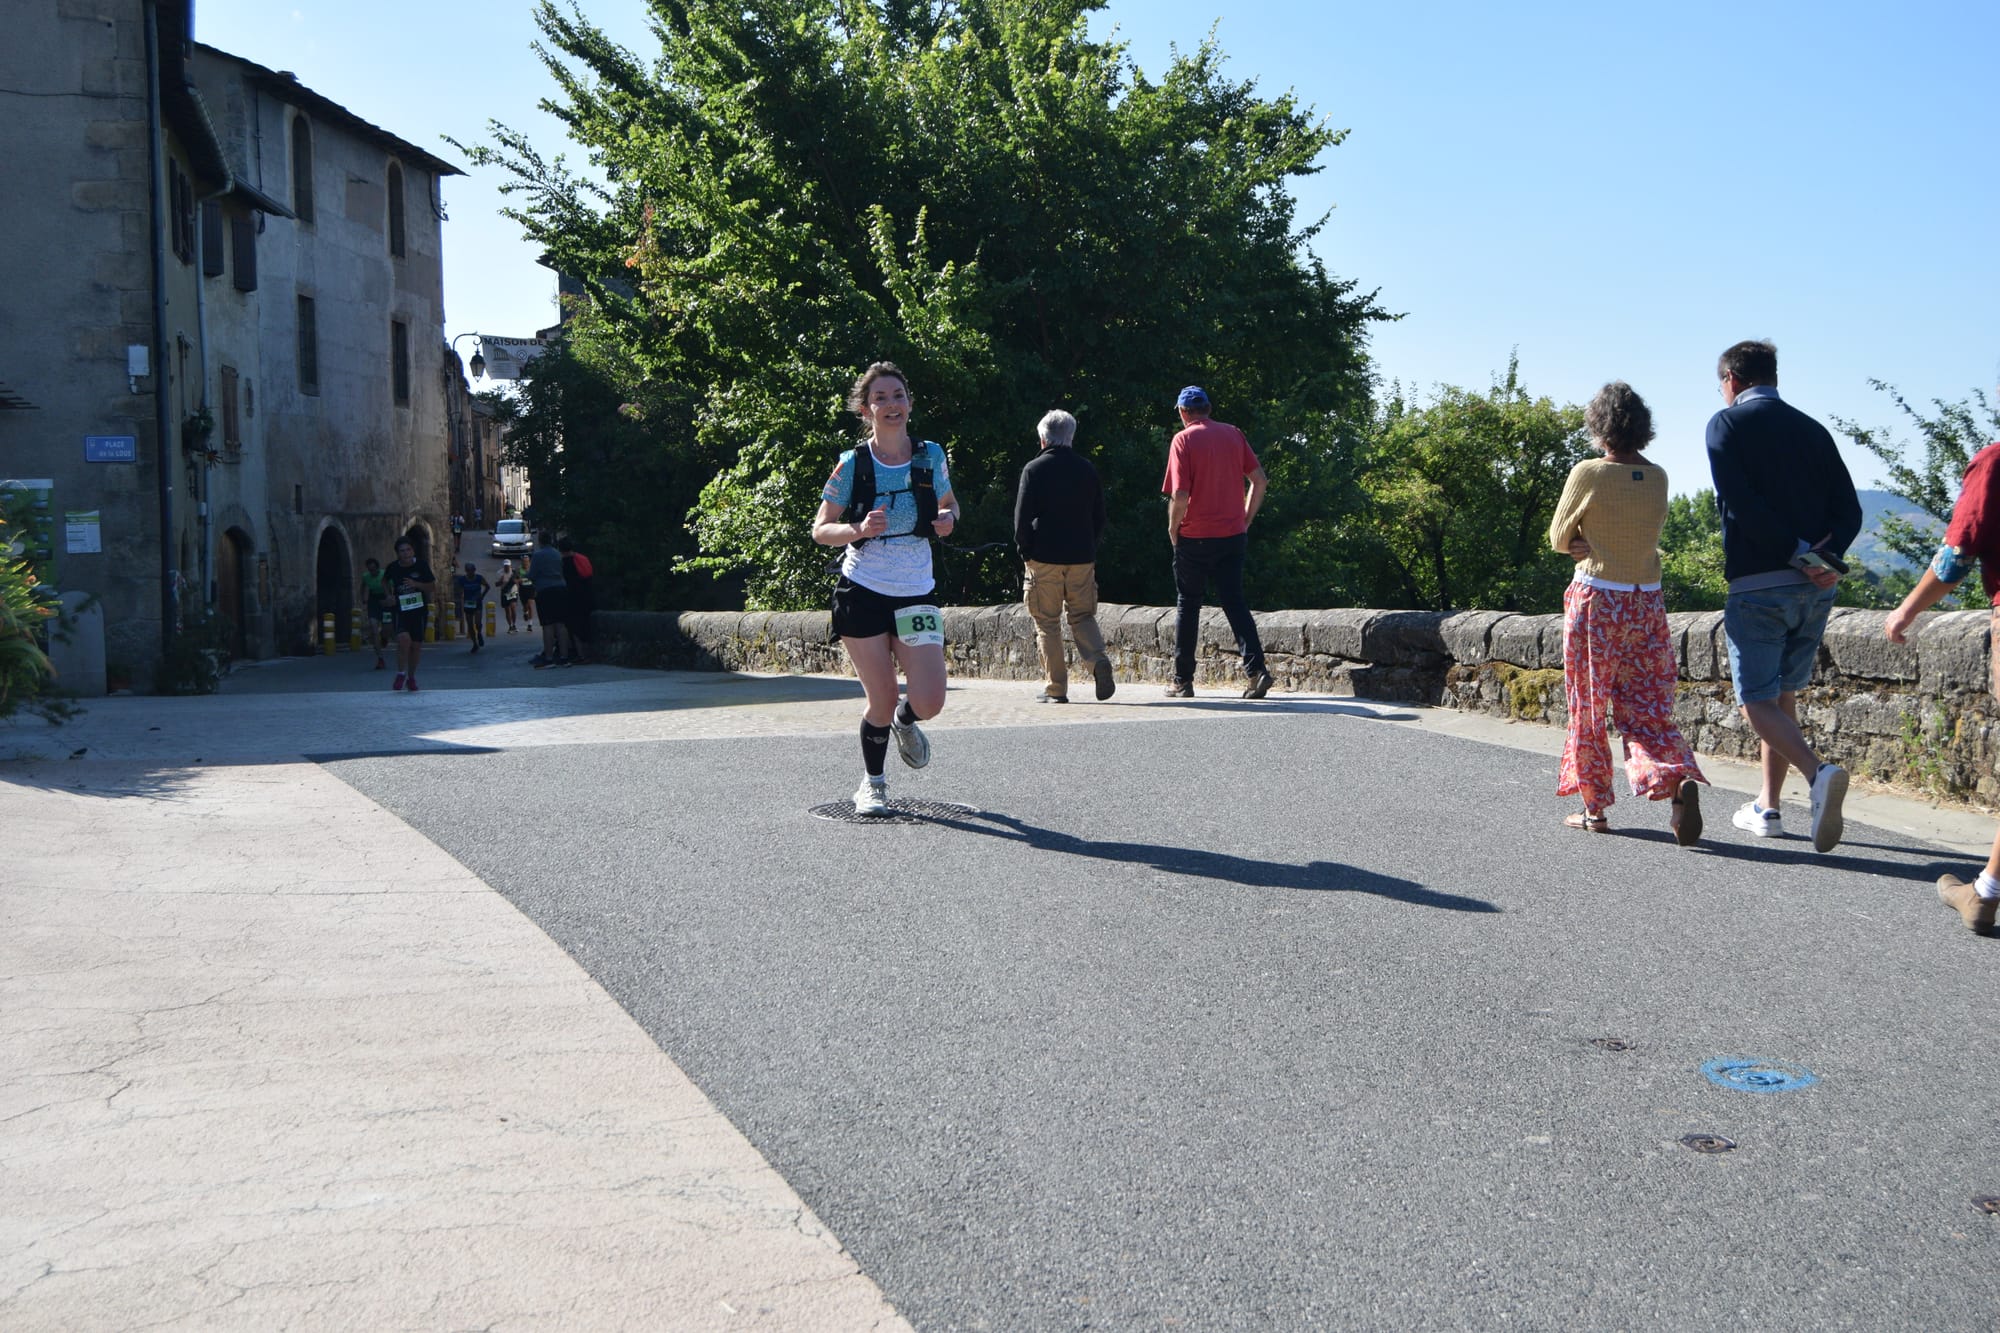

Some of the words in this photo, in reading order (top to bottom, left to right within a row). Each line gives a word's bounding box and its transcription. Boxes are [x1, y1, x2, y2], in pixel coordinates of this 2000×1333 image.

[484, 337, 527, 346] MAISON
[105, 440, 124, 448] PLACE
[912, 615, 936, 631] 83
